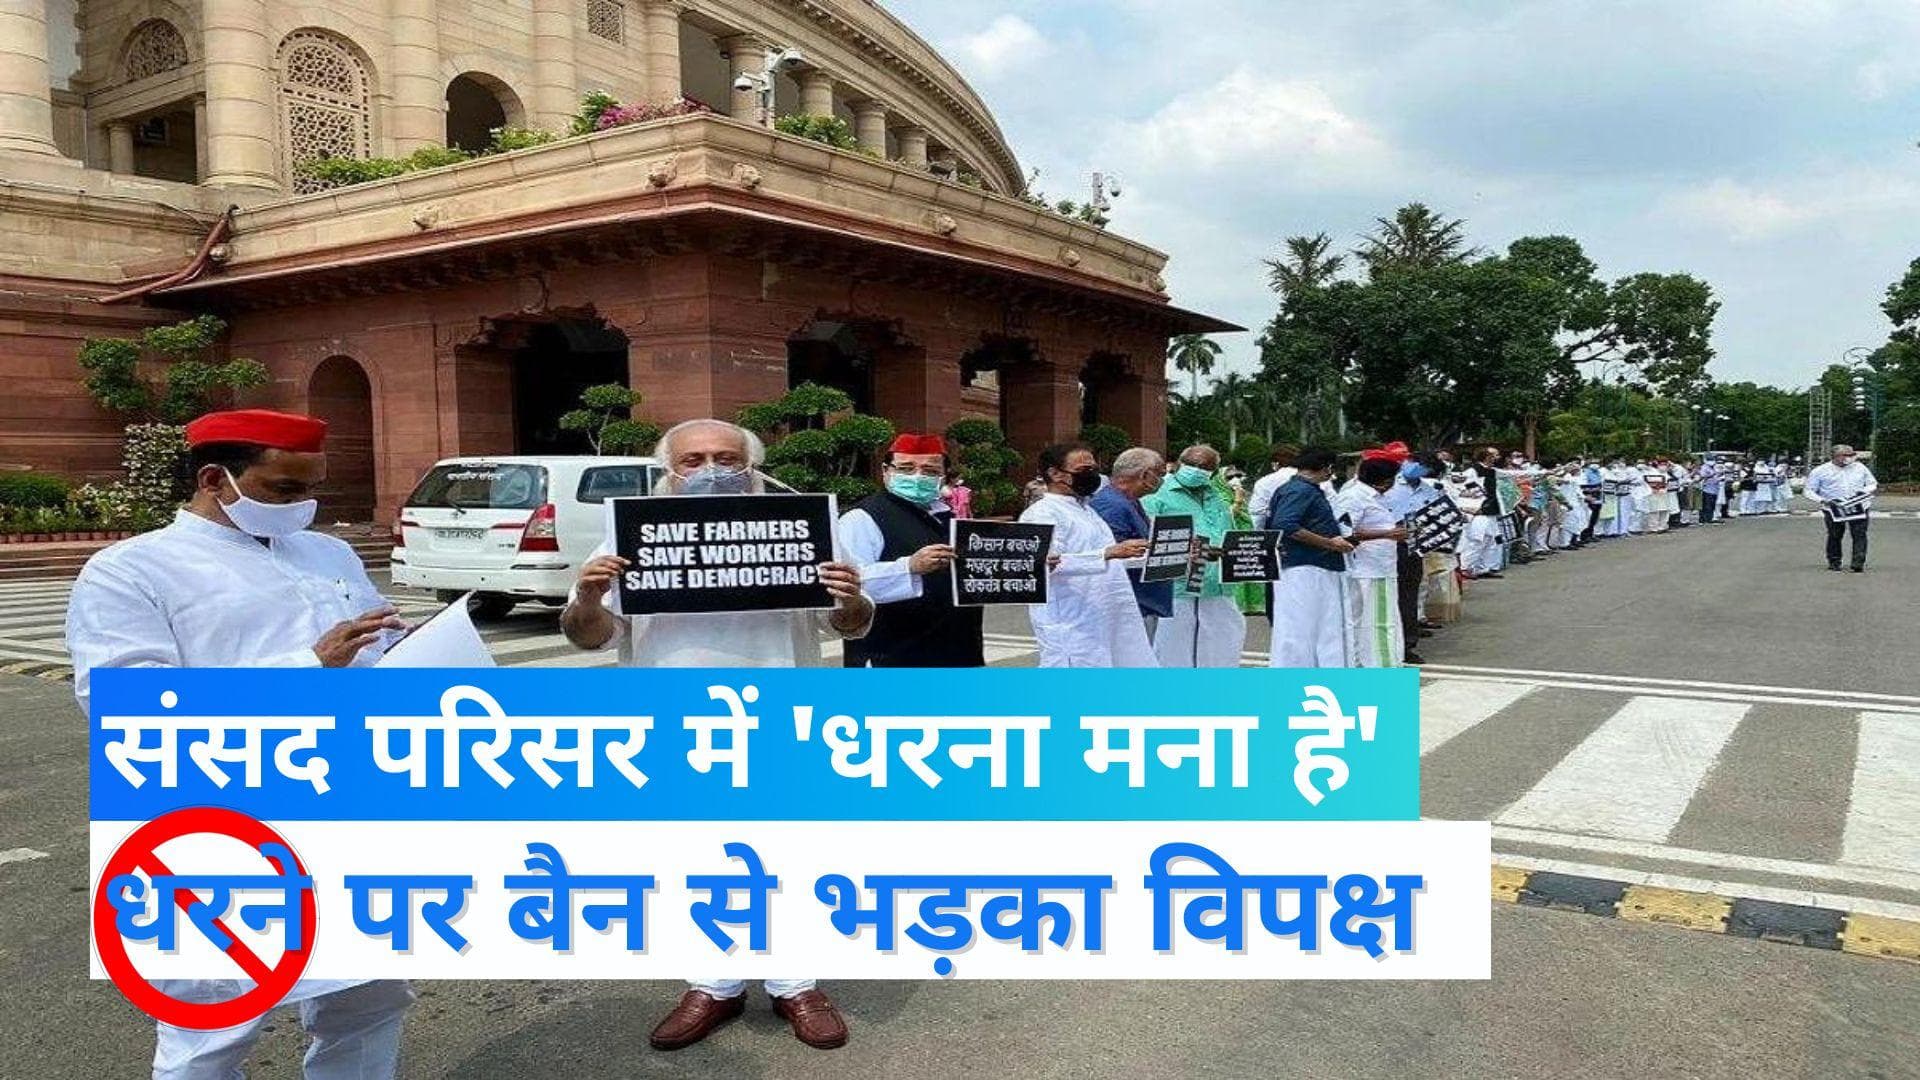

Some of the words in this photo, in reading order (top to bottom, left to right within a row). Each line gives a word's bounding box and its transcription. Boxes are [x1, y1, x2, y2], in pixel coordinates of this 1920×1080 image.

[640, 523, 699, 543] SAVE
[704, 519, 810, 541] FARMERS
[968, 533, 1004, 551] किसान
[638, 547, 697, 566] SAVE
[700, 542, 815, 564] WORKERS
[625, 570, 684, 590] SAVE
[688, 565, 820, 588] DEMOCRAC
